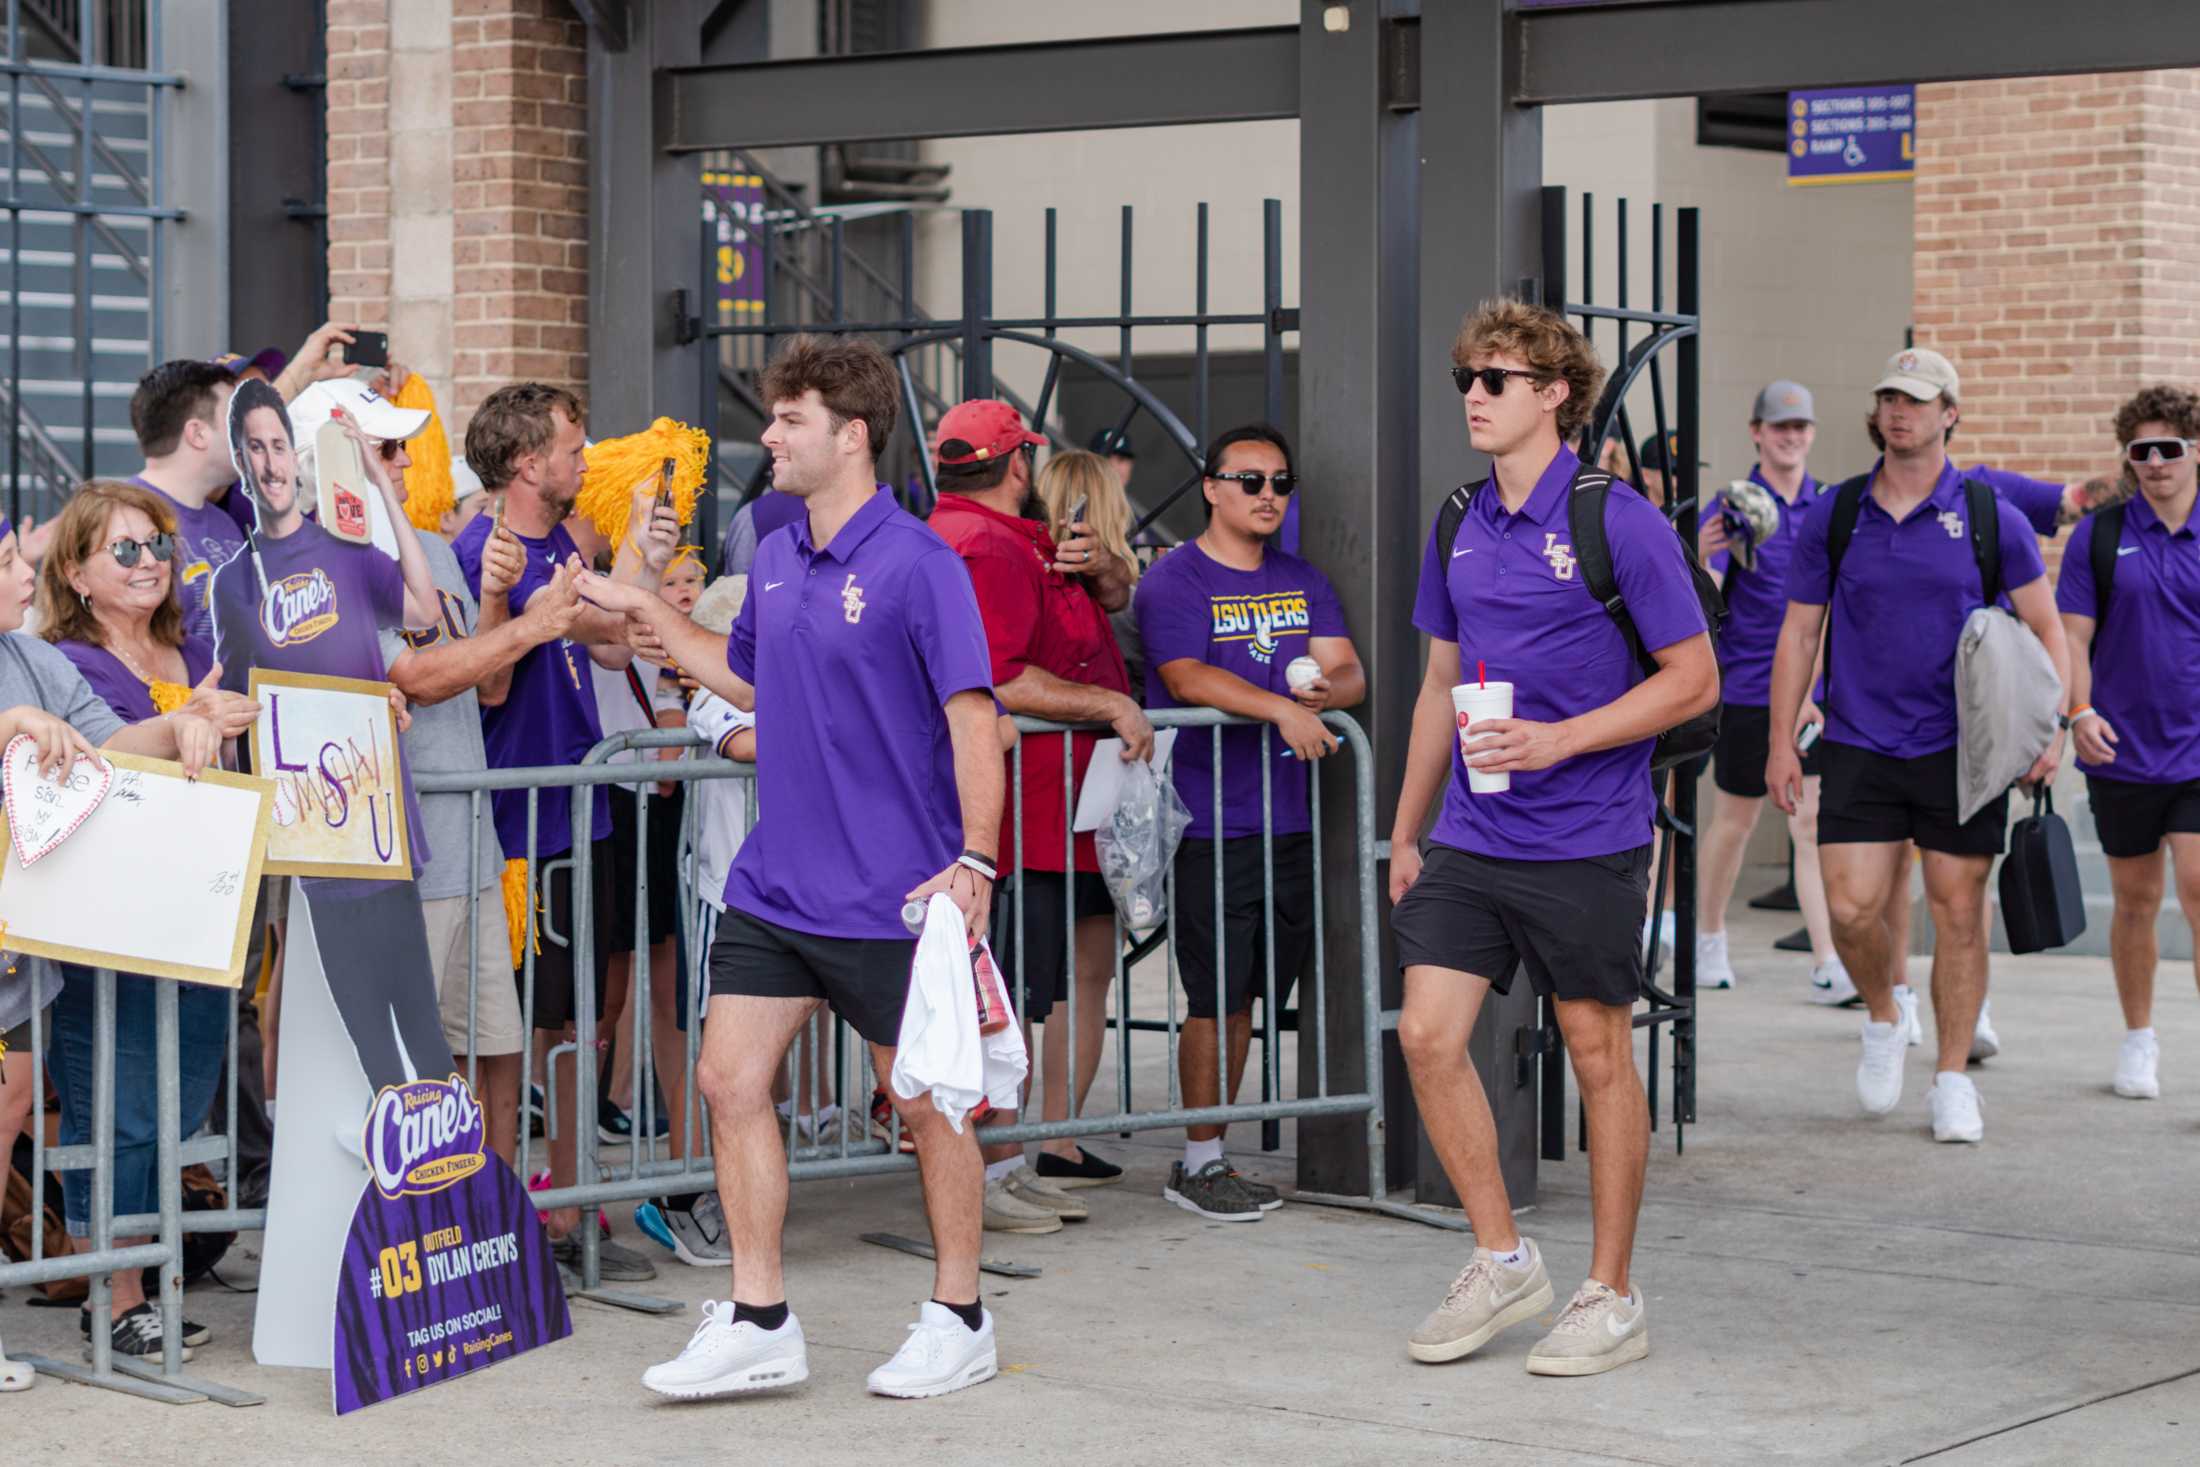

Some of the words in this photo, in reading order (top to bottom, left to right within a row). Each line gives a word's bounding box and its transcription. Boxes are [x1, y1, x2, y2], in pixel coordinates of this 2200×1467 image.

[1543, 532, 1577, 580] LSU
[841, 573, 867, 624] LSU
[1212, 602, 1251, 634] LSU
[404, 1087, 442, 1113] Raising
[373, 1078, 479, 1190] Cane's
[423, 1225, 463, 1252] OUTFIELD
[427, 1246, 472, 1286] DYLAN
[472, 1232, 518, 1272] CREWS
[370, 1240, 422, 1298] #03
[407, 1328, 430, 1348] TAG
[430, 1322, 446, 1341] US
[445, 1316, 463, 1336] ON
[462, 1303, 503, 1330] SOCIAL!
[463, 1331, 514, 1356] RaisingCanes
